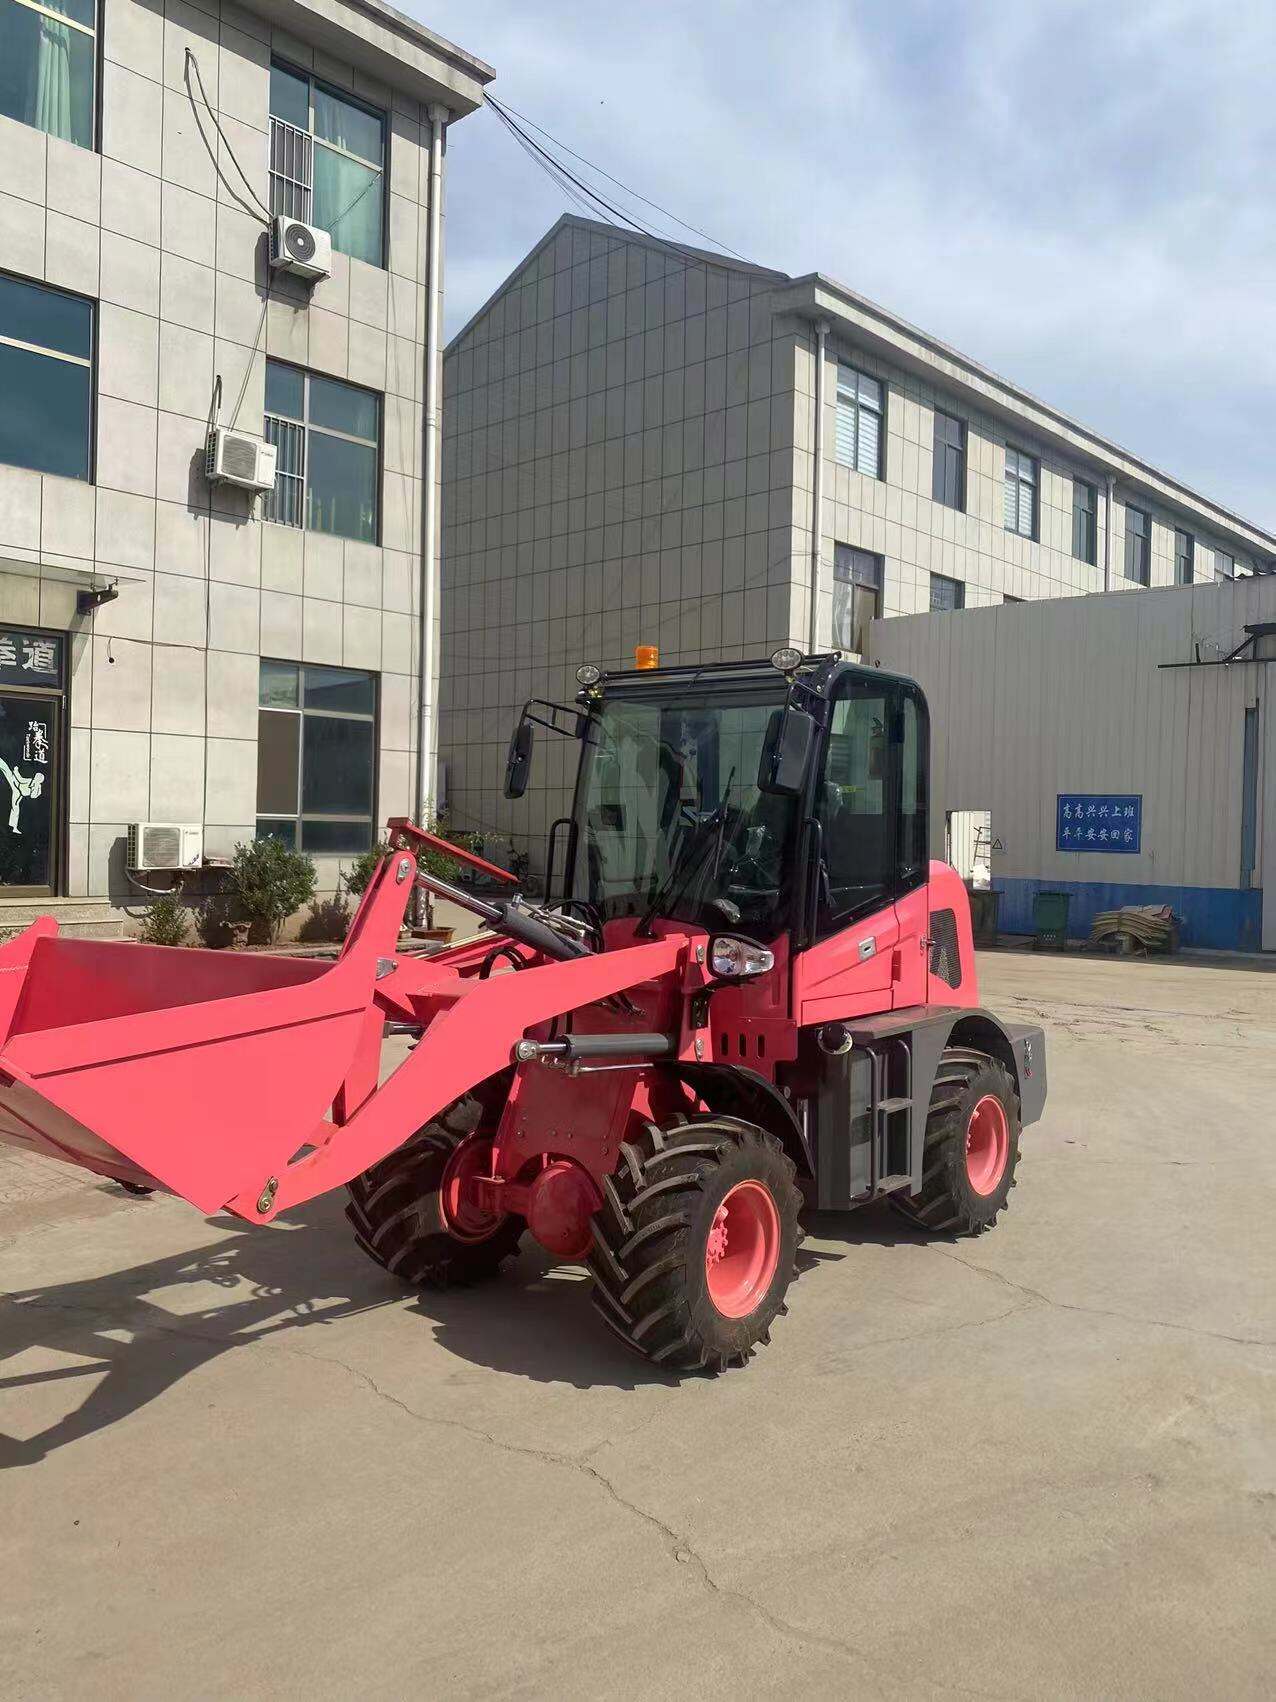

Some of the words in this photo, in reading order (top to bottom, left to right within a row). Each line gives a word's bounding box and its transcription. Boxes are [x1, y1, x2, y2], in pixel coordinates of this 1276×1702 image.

[1063, 803, 1135, 819] 高高兴兴上班
[1062, 826, 1133, 842] 平平安安回家
